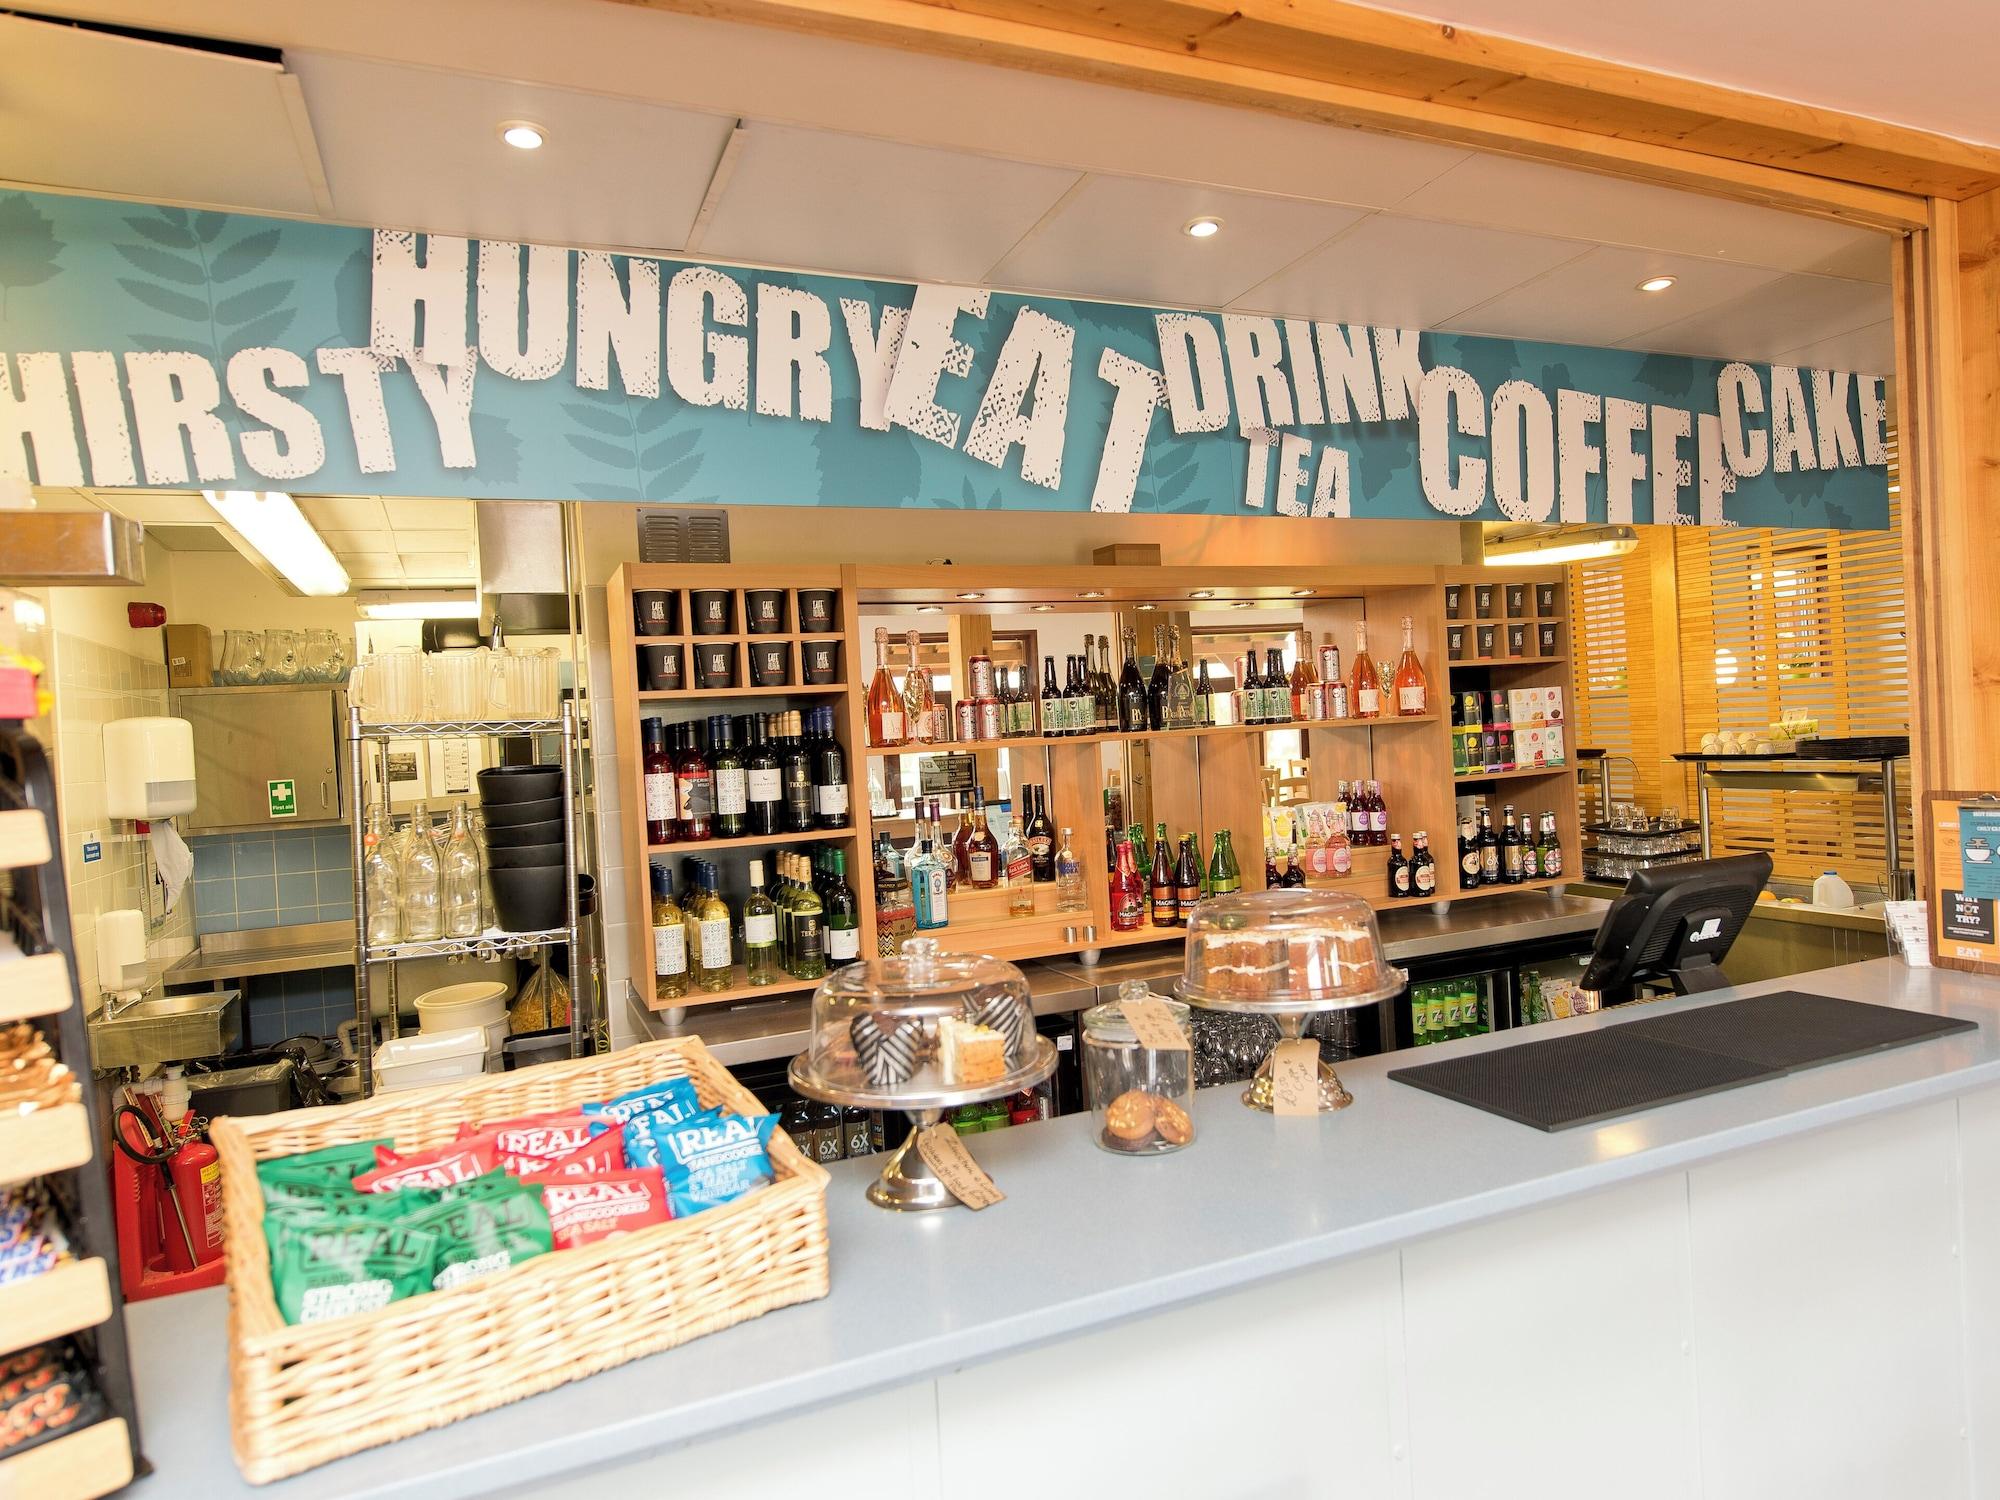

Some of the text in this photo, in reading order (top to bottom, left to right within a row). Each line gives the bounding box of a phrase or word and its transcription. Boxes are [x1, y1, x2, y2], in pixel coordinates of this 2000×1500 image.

[371, 228, 910, 431] HUNGRY
[1155, 312, 1424, 434] DRINK
[884, 284, 1168, 513] EAT
[1717, 361, 1888, 478] CAKE
[1243, 427, 1350, 518] TEA
[1955, 914, 1981, 925] TRY?
[1956, 903, 1979, 914] NOT
[507, 1128, 592, 1157] REAL
[819, 1139, 838, 1155] 6X
[851, 1132, 869, 1149] 6X
[545, 1180, 644, 1212] REAL
[307, 1224, 418, 1264] REAL
